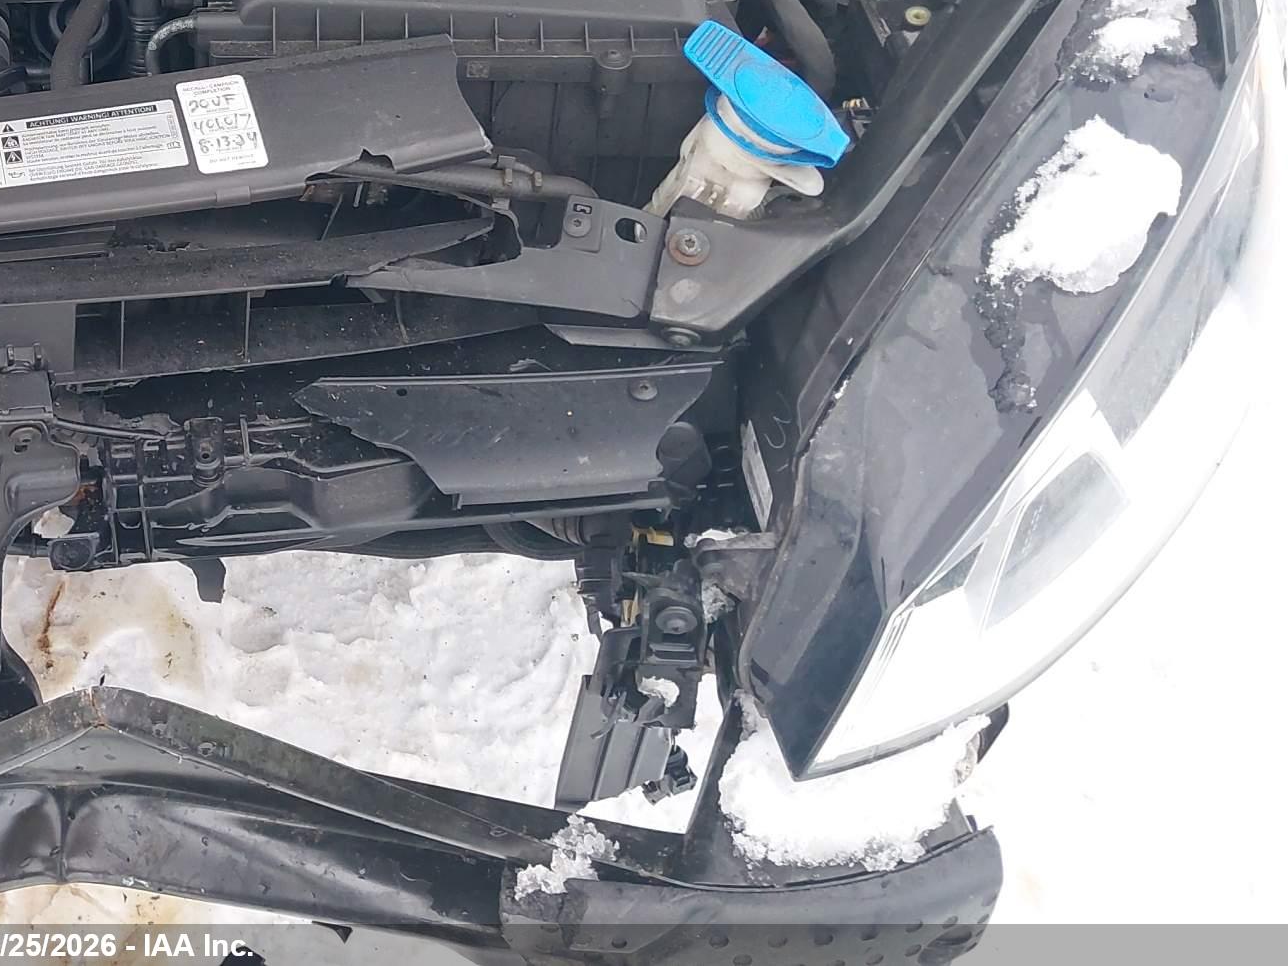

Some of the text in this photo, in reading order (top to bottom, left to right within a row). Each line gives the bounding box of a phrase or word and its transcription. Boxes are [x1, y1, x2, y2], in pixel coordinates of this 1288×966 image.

[29, 105, 154, 128] ACHTUNG! WARNING! ATTENTION!
